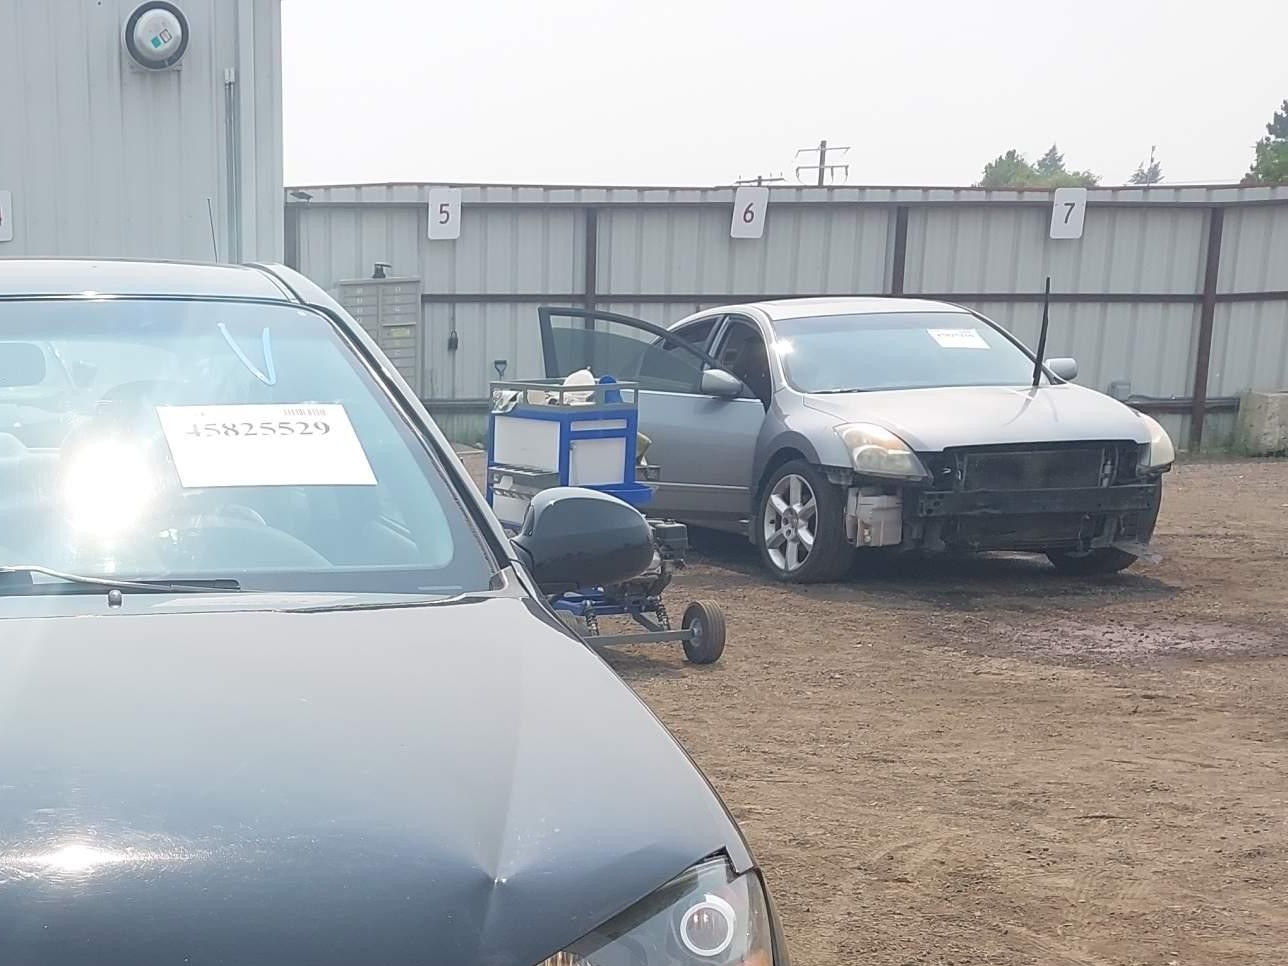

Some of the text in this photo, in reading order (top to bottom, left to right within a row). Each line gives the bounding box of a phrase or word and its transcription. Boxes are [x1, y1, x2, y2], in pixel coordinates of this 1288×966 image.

[439, 203, 450, 224] 5
[742, 202, 755, 223] 6
[1063, 203, 1076, 224] 7
